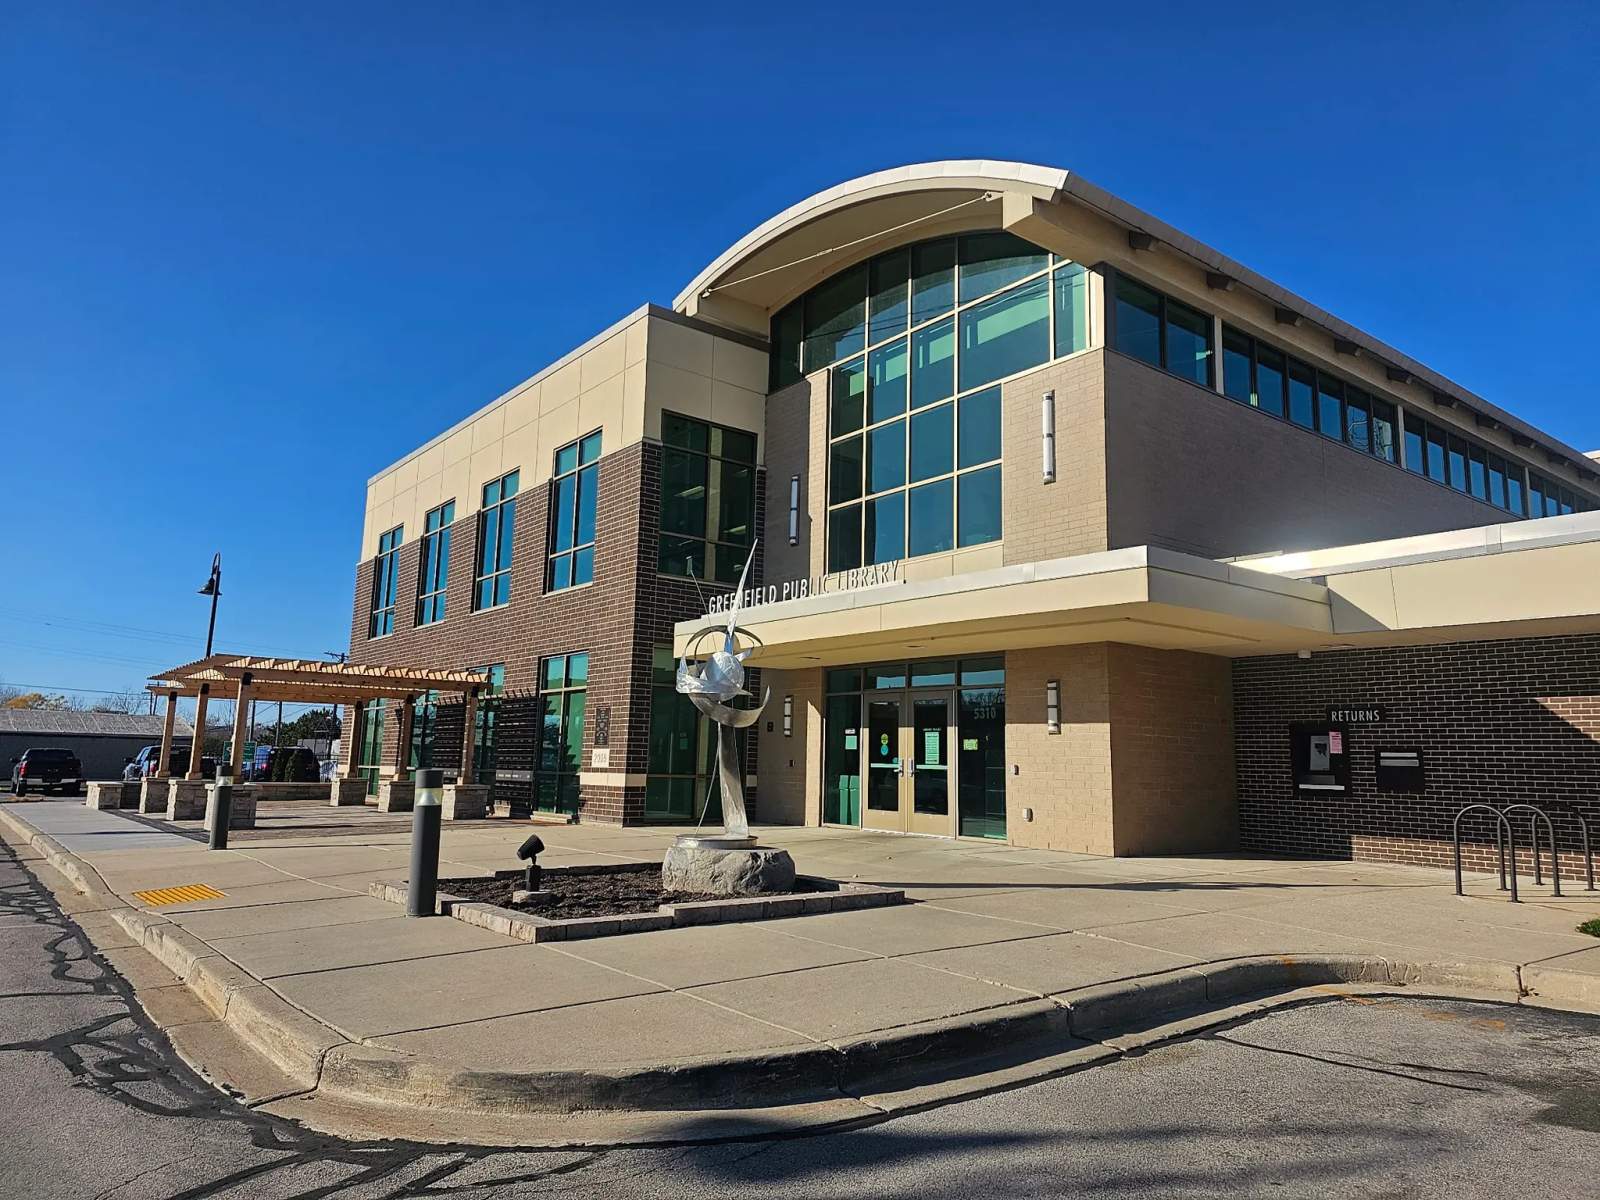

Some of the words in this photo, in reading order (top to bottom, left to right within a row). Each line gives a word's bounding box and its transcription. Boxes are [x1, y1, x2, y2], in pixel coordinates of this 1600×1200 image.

[709, 584, 777, 615] GREENFIELD
[783, 574, 829, 602] PUBLIC
[837, 559, 899, 591] LIBRARY
[973, 706, 996, 720] 5310
[1331, 709, 1380, 722] RETURNS
